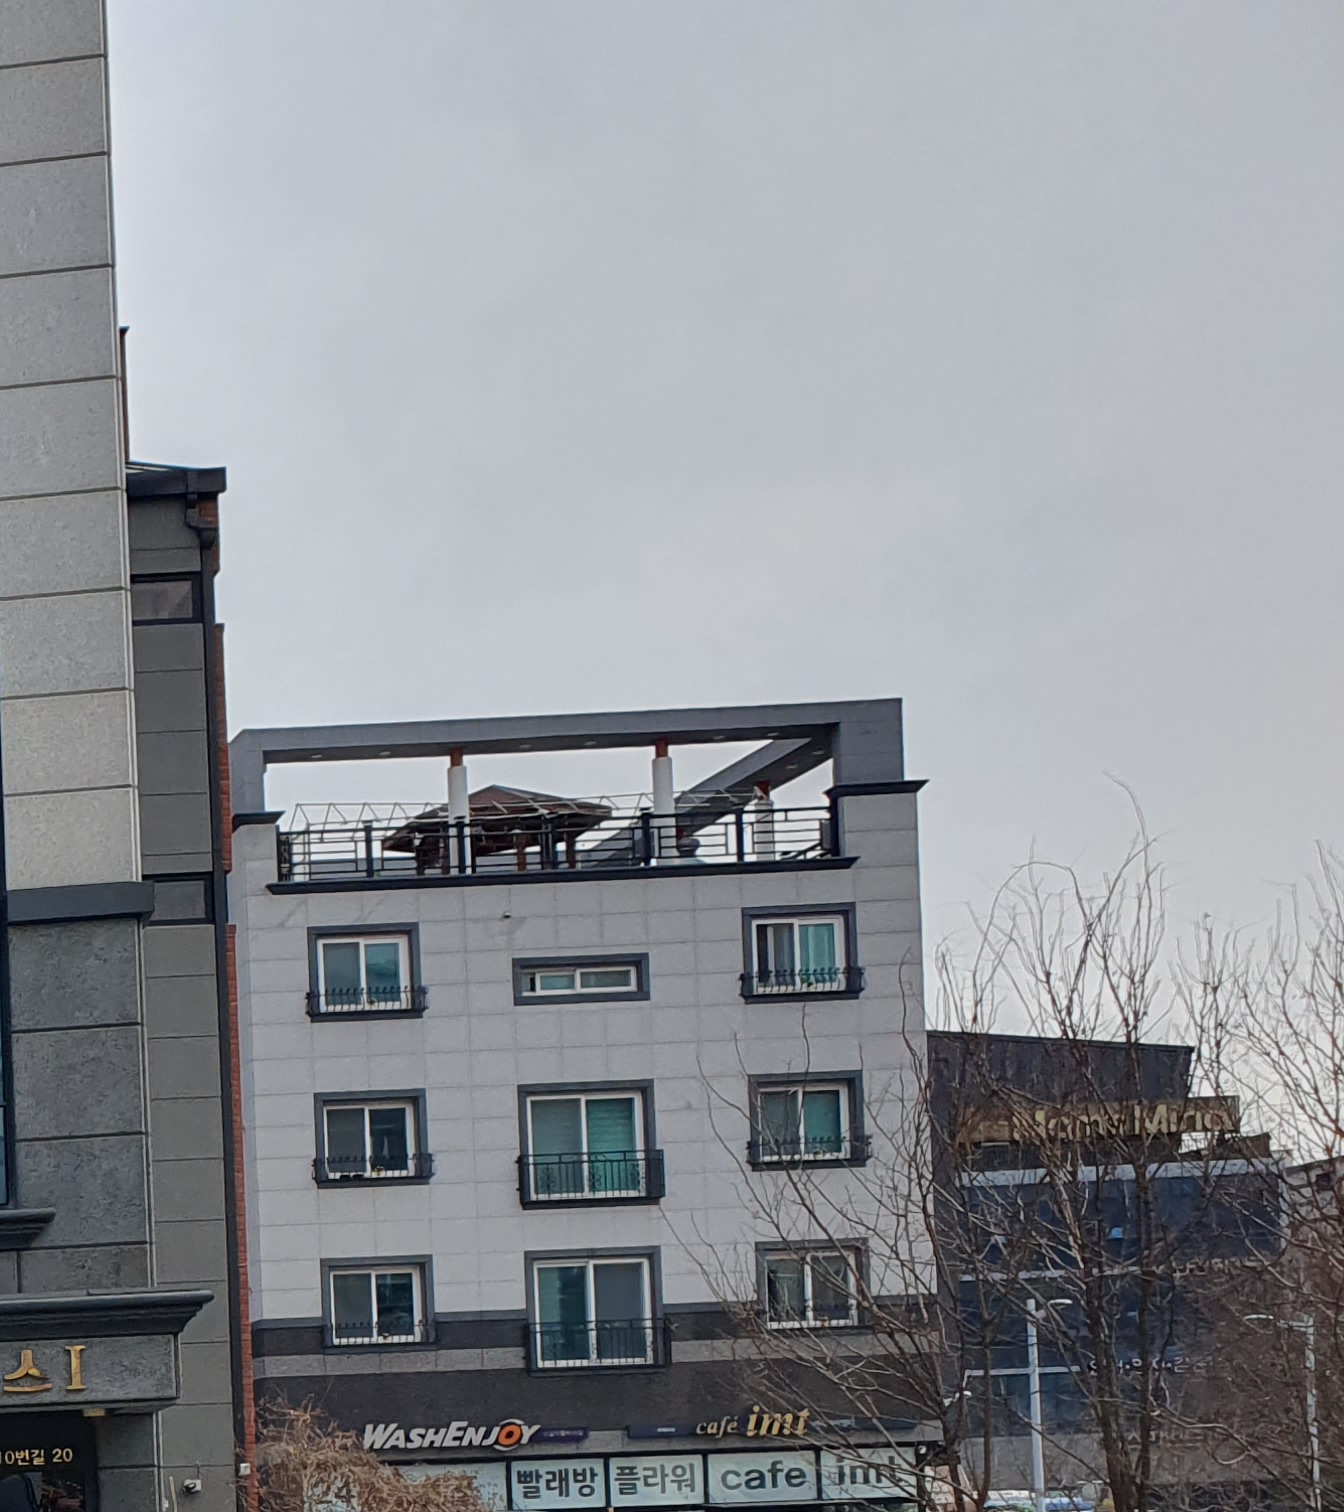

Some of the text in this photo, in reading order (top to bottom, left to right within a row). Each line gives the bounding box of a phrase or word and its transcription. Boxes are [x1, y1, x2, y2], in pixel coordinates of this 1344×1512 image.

[52, 1447, 73, 1463] 20
[516, 1466, 599, 1500] 빨래방
[613, 1462, 696, 1496] 플라워
[720, 1460, 808, 1491] cafe
